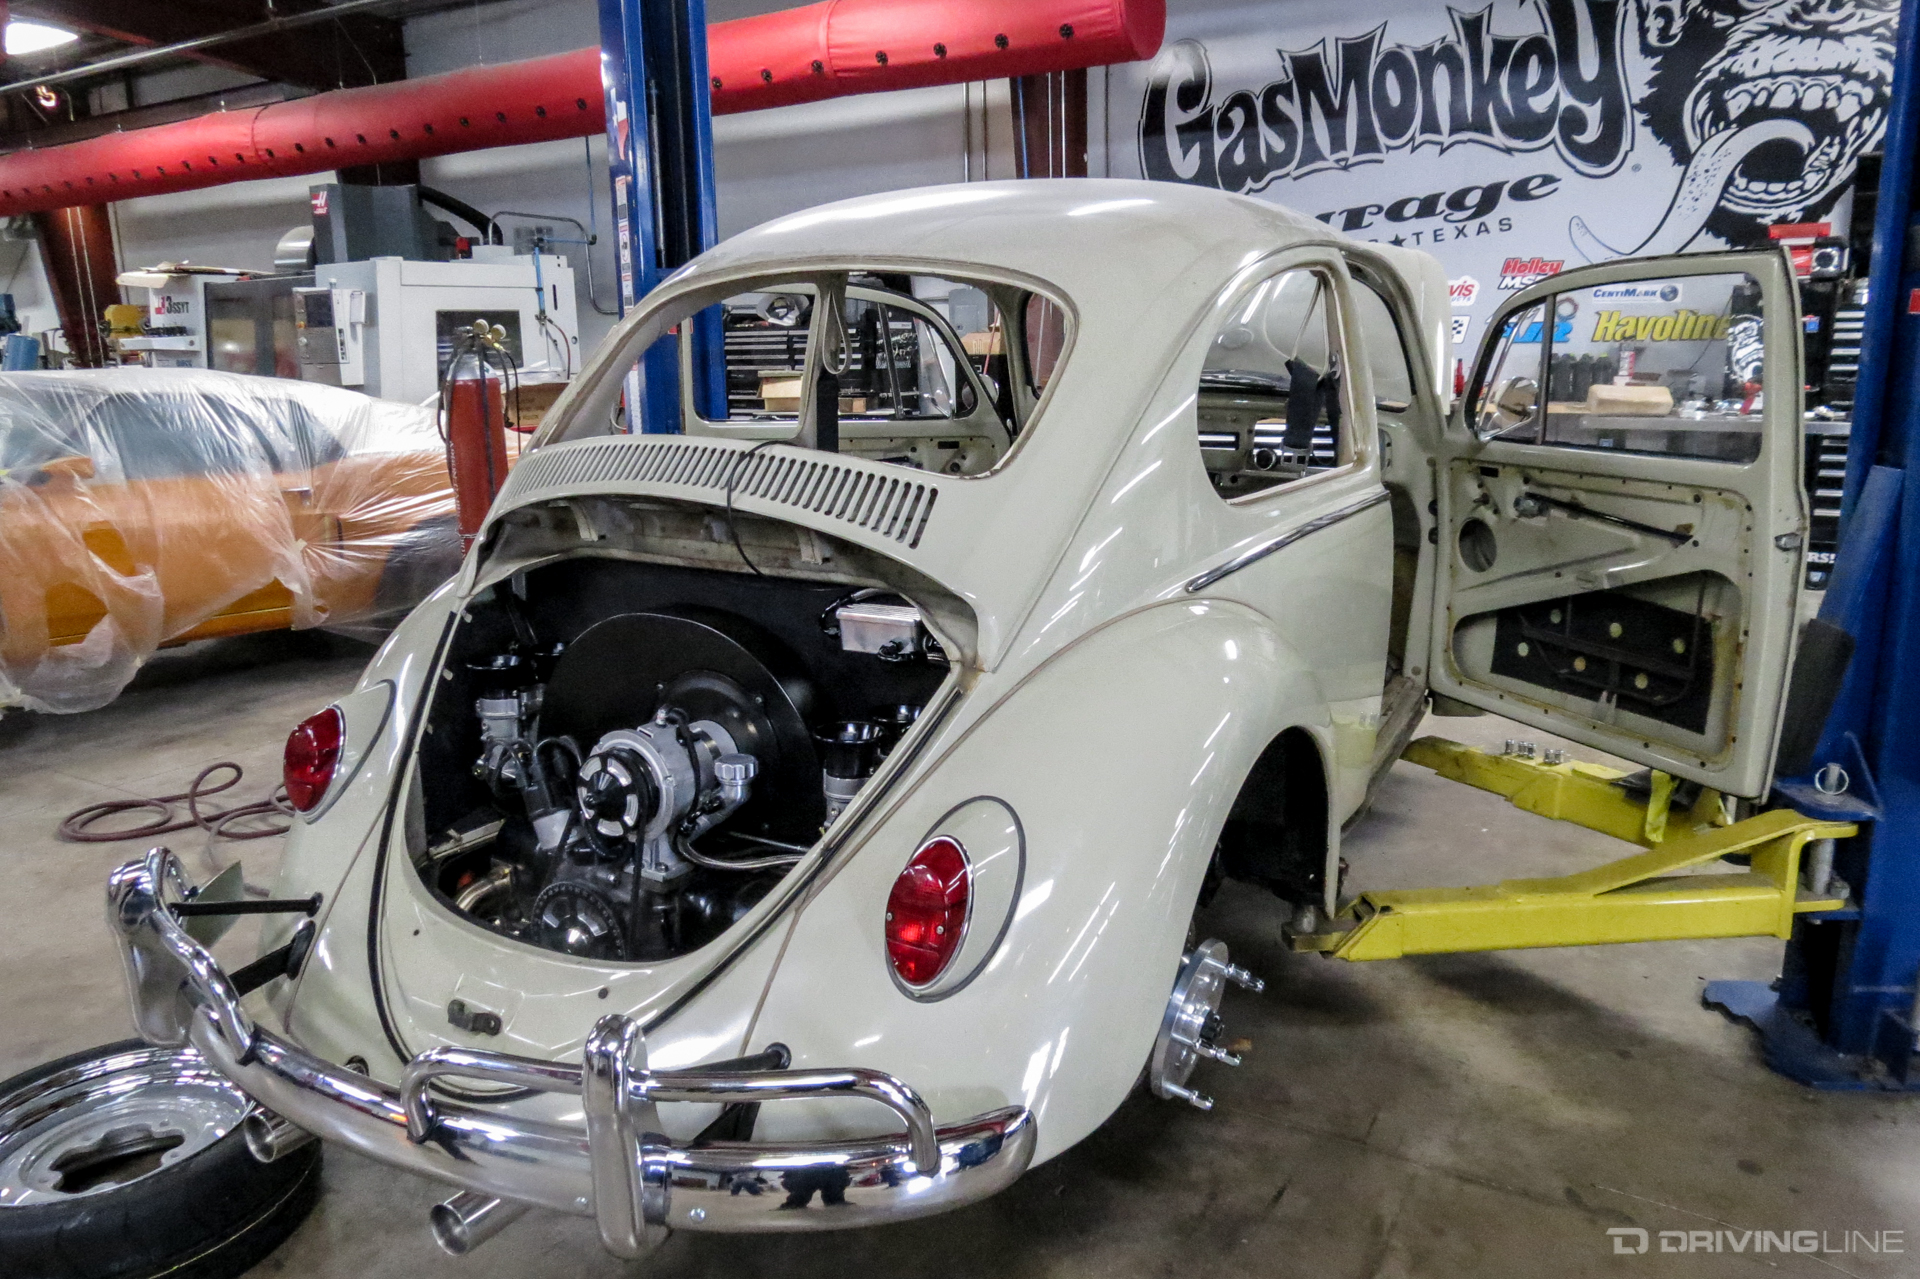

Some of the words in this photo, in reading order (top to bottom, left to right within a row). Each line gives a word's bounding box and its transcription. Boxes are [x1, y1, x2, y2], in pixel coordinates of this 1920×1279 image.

[1412, 217, 1513, 246] TEXAS
[1501, 257, 1564, 277] Holley
[1497, 276, 1547, 290] MS
[1591, 309, 1730, 342] Havoline
